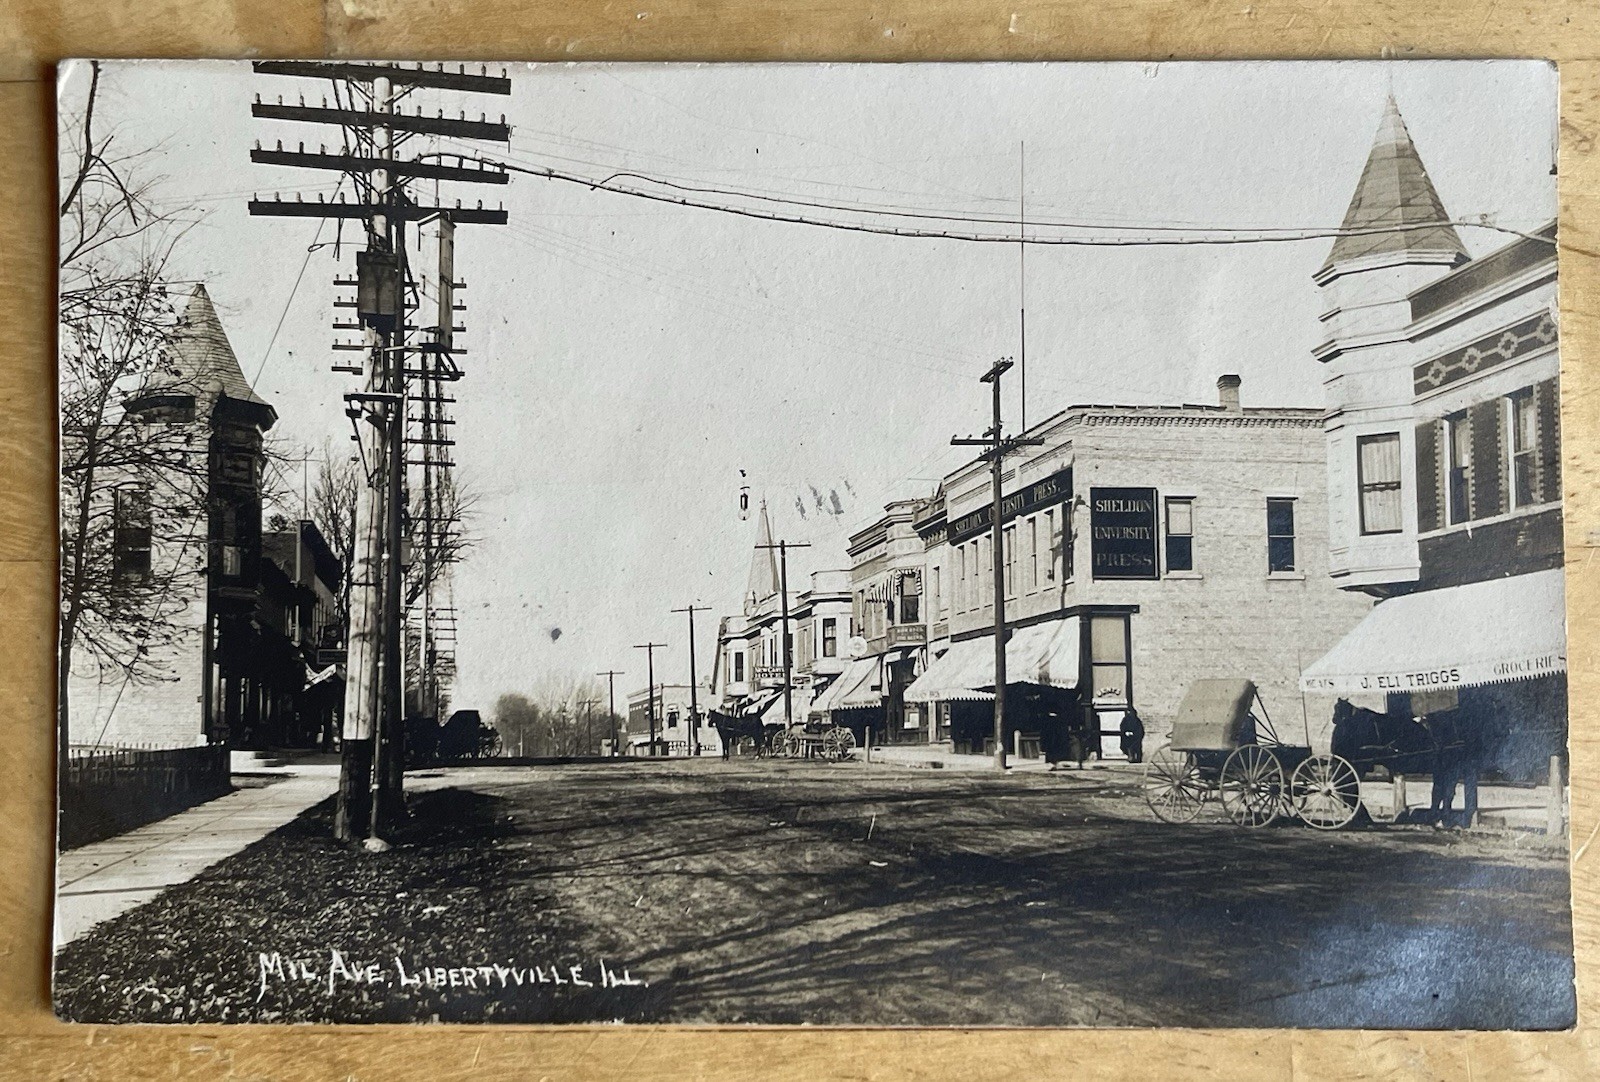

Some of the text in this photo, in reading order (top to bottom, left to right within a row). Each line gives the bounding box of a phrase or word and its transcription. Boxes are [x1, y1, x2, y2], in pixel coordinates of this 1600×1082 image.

[1095, 499, 1152, 513] SHELDON
[955, 511, 983, 532] SHELDON
[1094, 526, 1152, 540] UNIVERSITY
[1096, 553, 1152, 567] PRESS
[1360, 669, 1460, 689] J. ELI TRIGGS
[395, 956, 593, 988] LIBERTYVILLE
[600, 958, 649, 988] ILL.
